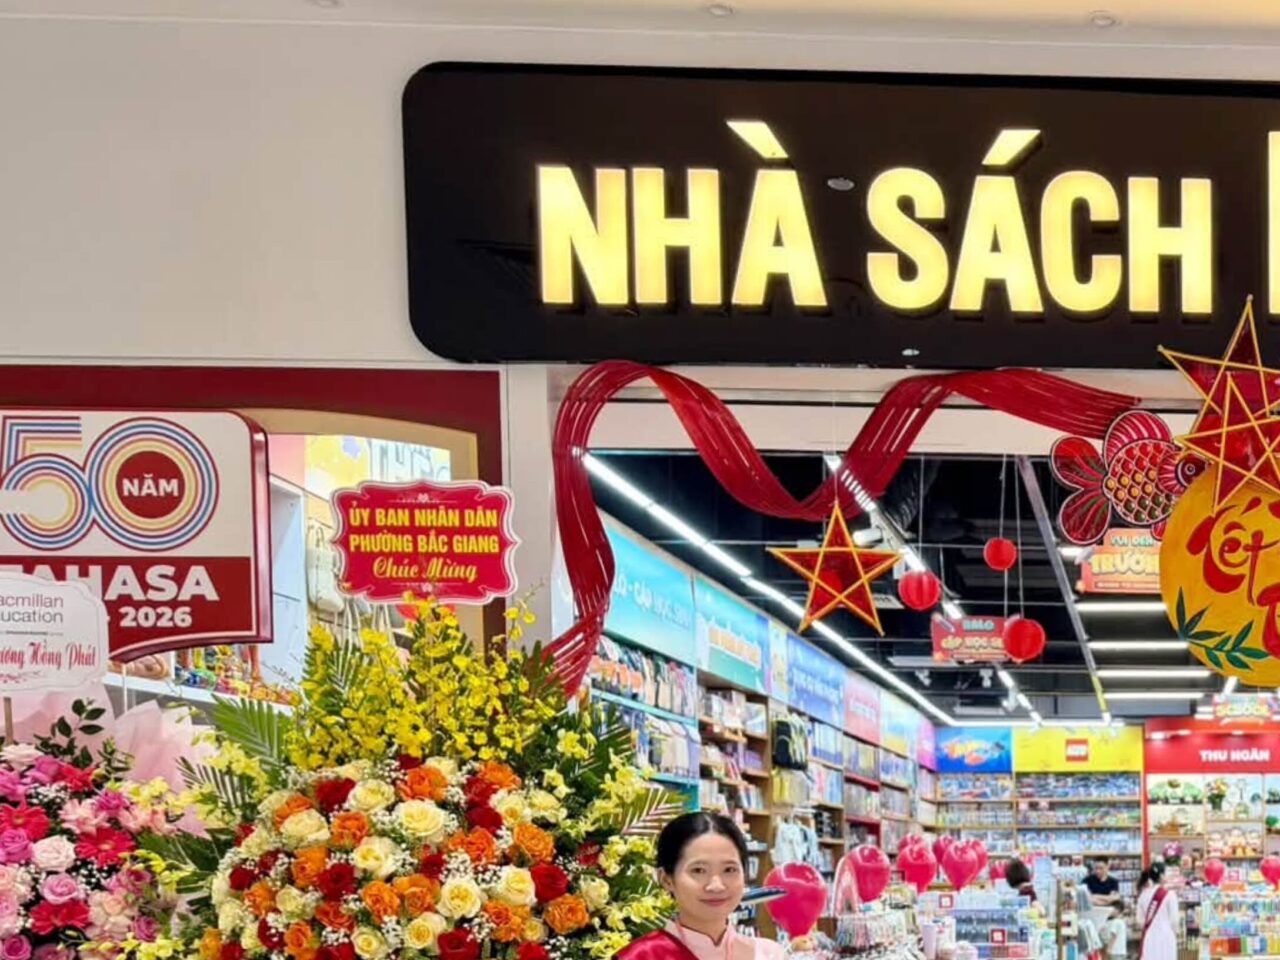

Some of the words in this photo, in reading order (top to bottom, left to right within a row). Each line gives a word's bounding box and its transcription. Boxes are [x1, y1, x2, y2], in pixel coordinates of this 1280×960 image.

[537, 119, 828, 306] NHÀ
[866, 128, 1213, 314] SÁCH
[121, 473, 179, 497] NĂM
[349, 500, 371, 527] ỦY
[375, 508, 410, 527] BAN
[414, 505, 460, 527] NHÂN
[464, 505, 498, 527] DÂN
[349, 529, 414, 553] PHƯỜNG
[417, 528, 449, 553] BẮC
[453, 534, 499, 553] GIANG
[0, 564, 220, 601] HASA
[373, 556, 420, 579] Chúc
[422, 557, 478, 583] Mừng
[118, 606, 193, 628] 2026
[1199, 749, 1229, 763] THU
